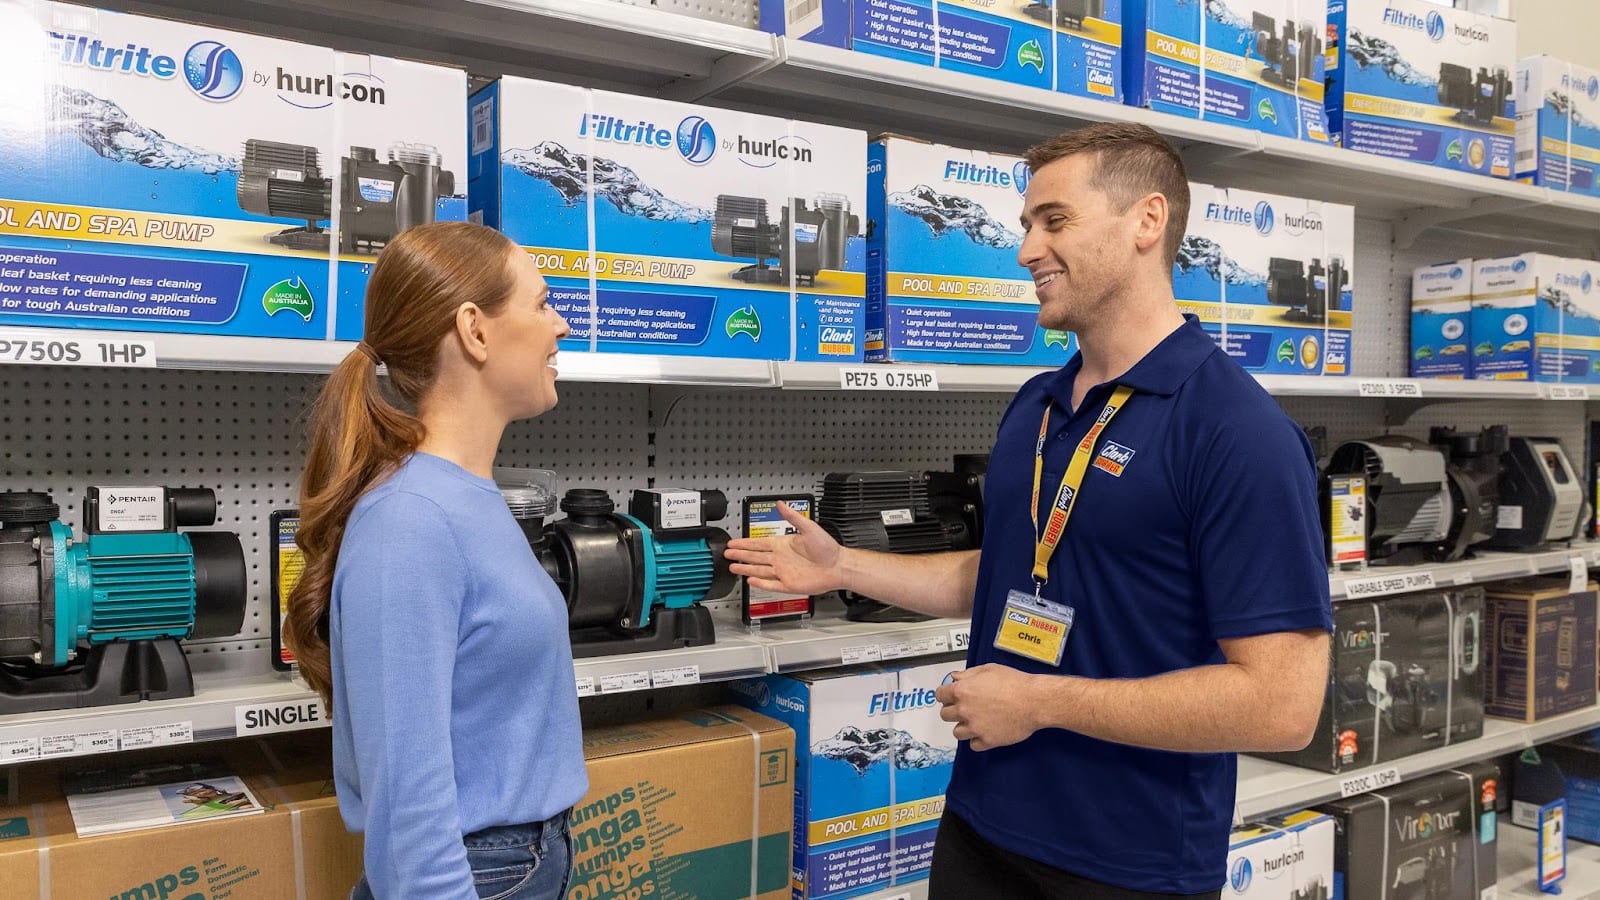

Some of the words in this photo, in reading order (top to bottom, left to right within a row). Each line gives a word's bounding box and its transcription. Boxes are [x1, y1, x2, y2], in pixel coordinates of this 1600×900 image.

[889, 4, 918, 15] operation
[1383, 8, 1425, 29] Filtrite
[871, 10, 888, 21] Large
[890, 14, 902, 22] leaf
[903, 15, 924, 28] basket
[952, 28, 965, 36] less
[965, 31, 989, 44] cleaning
[1454, 23, 1490, 43] hurlcon
[871, 21, 885, 31] High
[886, 24, 900, 34] flow
[901, 27, 918, 38] rates
[920, 30, 929, 40] for
[961, 40, 996, 54] applications
[871, 31, 888, 42] Made
[890, 35, 900, 44] for
[901, 38, 919, 50] tough
[952, 49, 982, 62] conditions
[1156, 39, 1178, 55] POOL
[1181, 45, 1199, 60] AND
[252, 69, 271, 87] by
[579, 113, 672, 148] Filtrite
[722, 138, 735, 152] by
[944, 160, 1011, 187] Filtrite
[1206, 202, 1252, 224] Fitrite
[1284, 212, 1323, 231] hurlcon
[25, 209, 81, 231] AND
[88, 214, 138, 237] SPA
[145, 218, 215, 242] PUMP
[0, 253, 57, 266] operation
[612, 260, 645, 276] SPA
[650, 262, 696, 279] PUMP
[1, 267, 25, 279] leaf
[28, 269, 70, 282] basket
[74, 273, 127, 287] requiring
[130, 276, 153, 287] less
[157, 278, 202, 292] cleaning
[903, 278, 934, 292] POOL
[936, 280, 963, 294] AND
[966, 282, 990, 296] SPA
[992, 283, 1026, 297] PUMP
[25, 284, 58, 295] rates
[62, 285, 81, 297] for
[84, 287, 147, 303] demanding
[150, 291, 217, 305] applications
[269, 297, 308, 305] AUSTRALIA
[553, 290, 591, 301] operation
[2, 298, 21, 309] for
[26, 299, 61, 312] tough
[64, 302, 128, 314] Australian
[132, 304, 190, 317] conditions
[555, 303, 571, 312] leaf
[571, 305, 598, 313] baskt
[602, 307, 636, 317] requiring
[638, 308, 653, 316] less
[656, 309, 685, 319] cleaning
[906, 309, 922, 317] Quiet
[923, 310, 952, 318] operation
[570, 316, 591, 325] rates
[608, 318, 650, 329] demanding
[651, 320, 696, 331] applications
[906, 319, 924, 328] Large
[570, 328, 591, 338] tough
[597, 329, 636, 339] Australian
[639, 331, 678, 341] conditions
[821, 327, 853, 343] Clark
[906, 329, 920, 338] High
[97, 343, 147, 363] 1HP
[906, 339, 923, 347] Made
[953, 341, 983, 349] Australian
[845, 372, 878, 387] PE75
[885, 372, 932, 387] 0.75HP
[1100, 406, 1114, 423] Clark
[1101, 444, 1130, 463] Clark
[1057, 485, 1073, 510] Clark
[1046, 510, 1065, 545] RUBBER
[1008, 611, 1029, 624] Clark
[1030, 617, 1059, 634] RUBBER
[1018, 632, 1041, 645] Chris
[775, 694, 805, 713] hurlcon
[245, 703, 319, 729] SINGLE
[569, 786, 636, 828] umps
[825, 817, 859, 837] POOL
[861, 812, 888, 831] AND
[203, 857, 220, 867] Spa
[574, 834, 646, 874] umps
[829, 851, 846, 861] Quiet
[846, 845, 876, 857] operation
[829, 862, 847, 872] Large
[860, 853, 882, 864] basket
[909, 844, 921, 852] less
[1263, 850, 1304, 873] hurlcon
[205, 862, 228, 875] Farm
[207, 864, 248, 885] Domestic
[829, 871, 844, 882] High
[844, 868, 859, 879] flow
[859, 866, 876, 875] rates
[876, 862, 886, 871] for
[209, 868, 261, 893] Commercial
[829, 881, 847, 891] Made
[848, 878, 858, 887] for
[859, 873, 877, 885] tough
